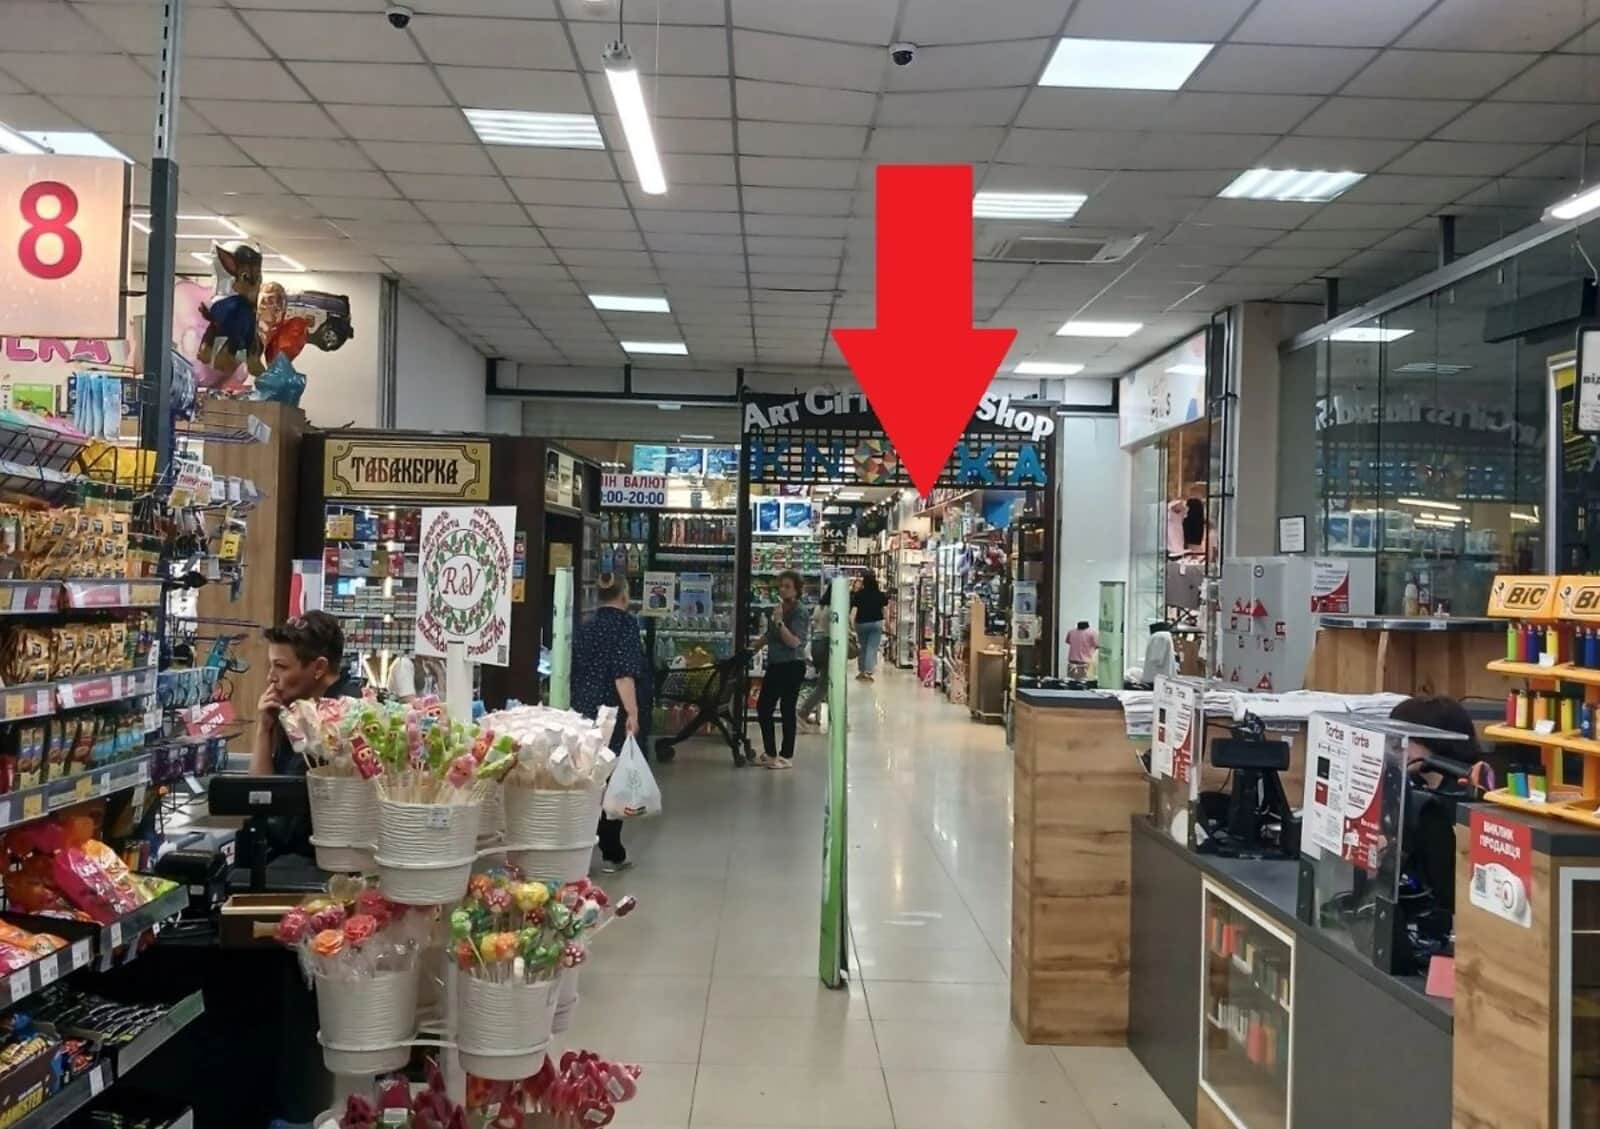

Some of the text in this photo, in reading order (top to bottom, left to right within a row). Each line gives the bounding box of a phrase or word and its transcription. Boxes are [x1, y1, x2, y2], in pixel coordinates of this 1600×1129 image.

[18, 180, 82, 280] 8
[975, 392, 1055, 442] Shop
[351, 456, 458, 485] ТАБАКЕРКА
[623, 476, 667, 489] ВАЛЮТ
